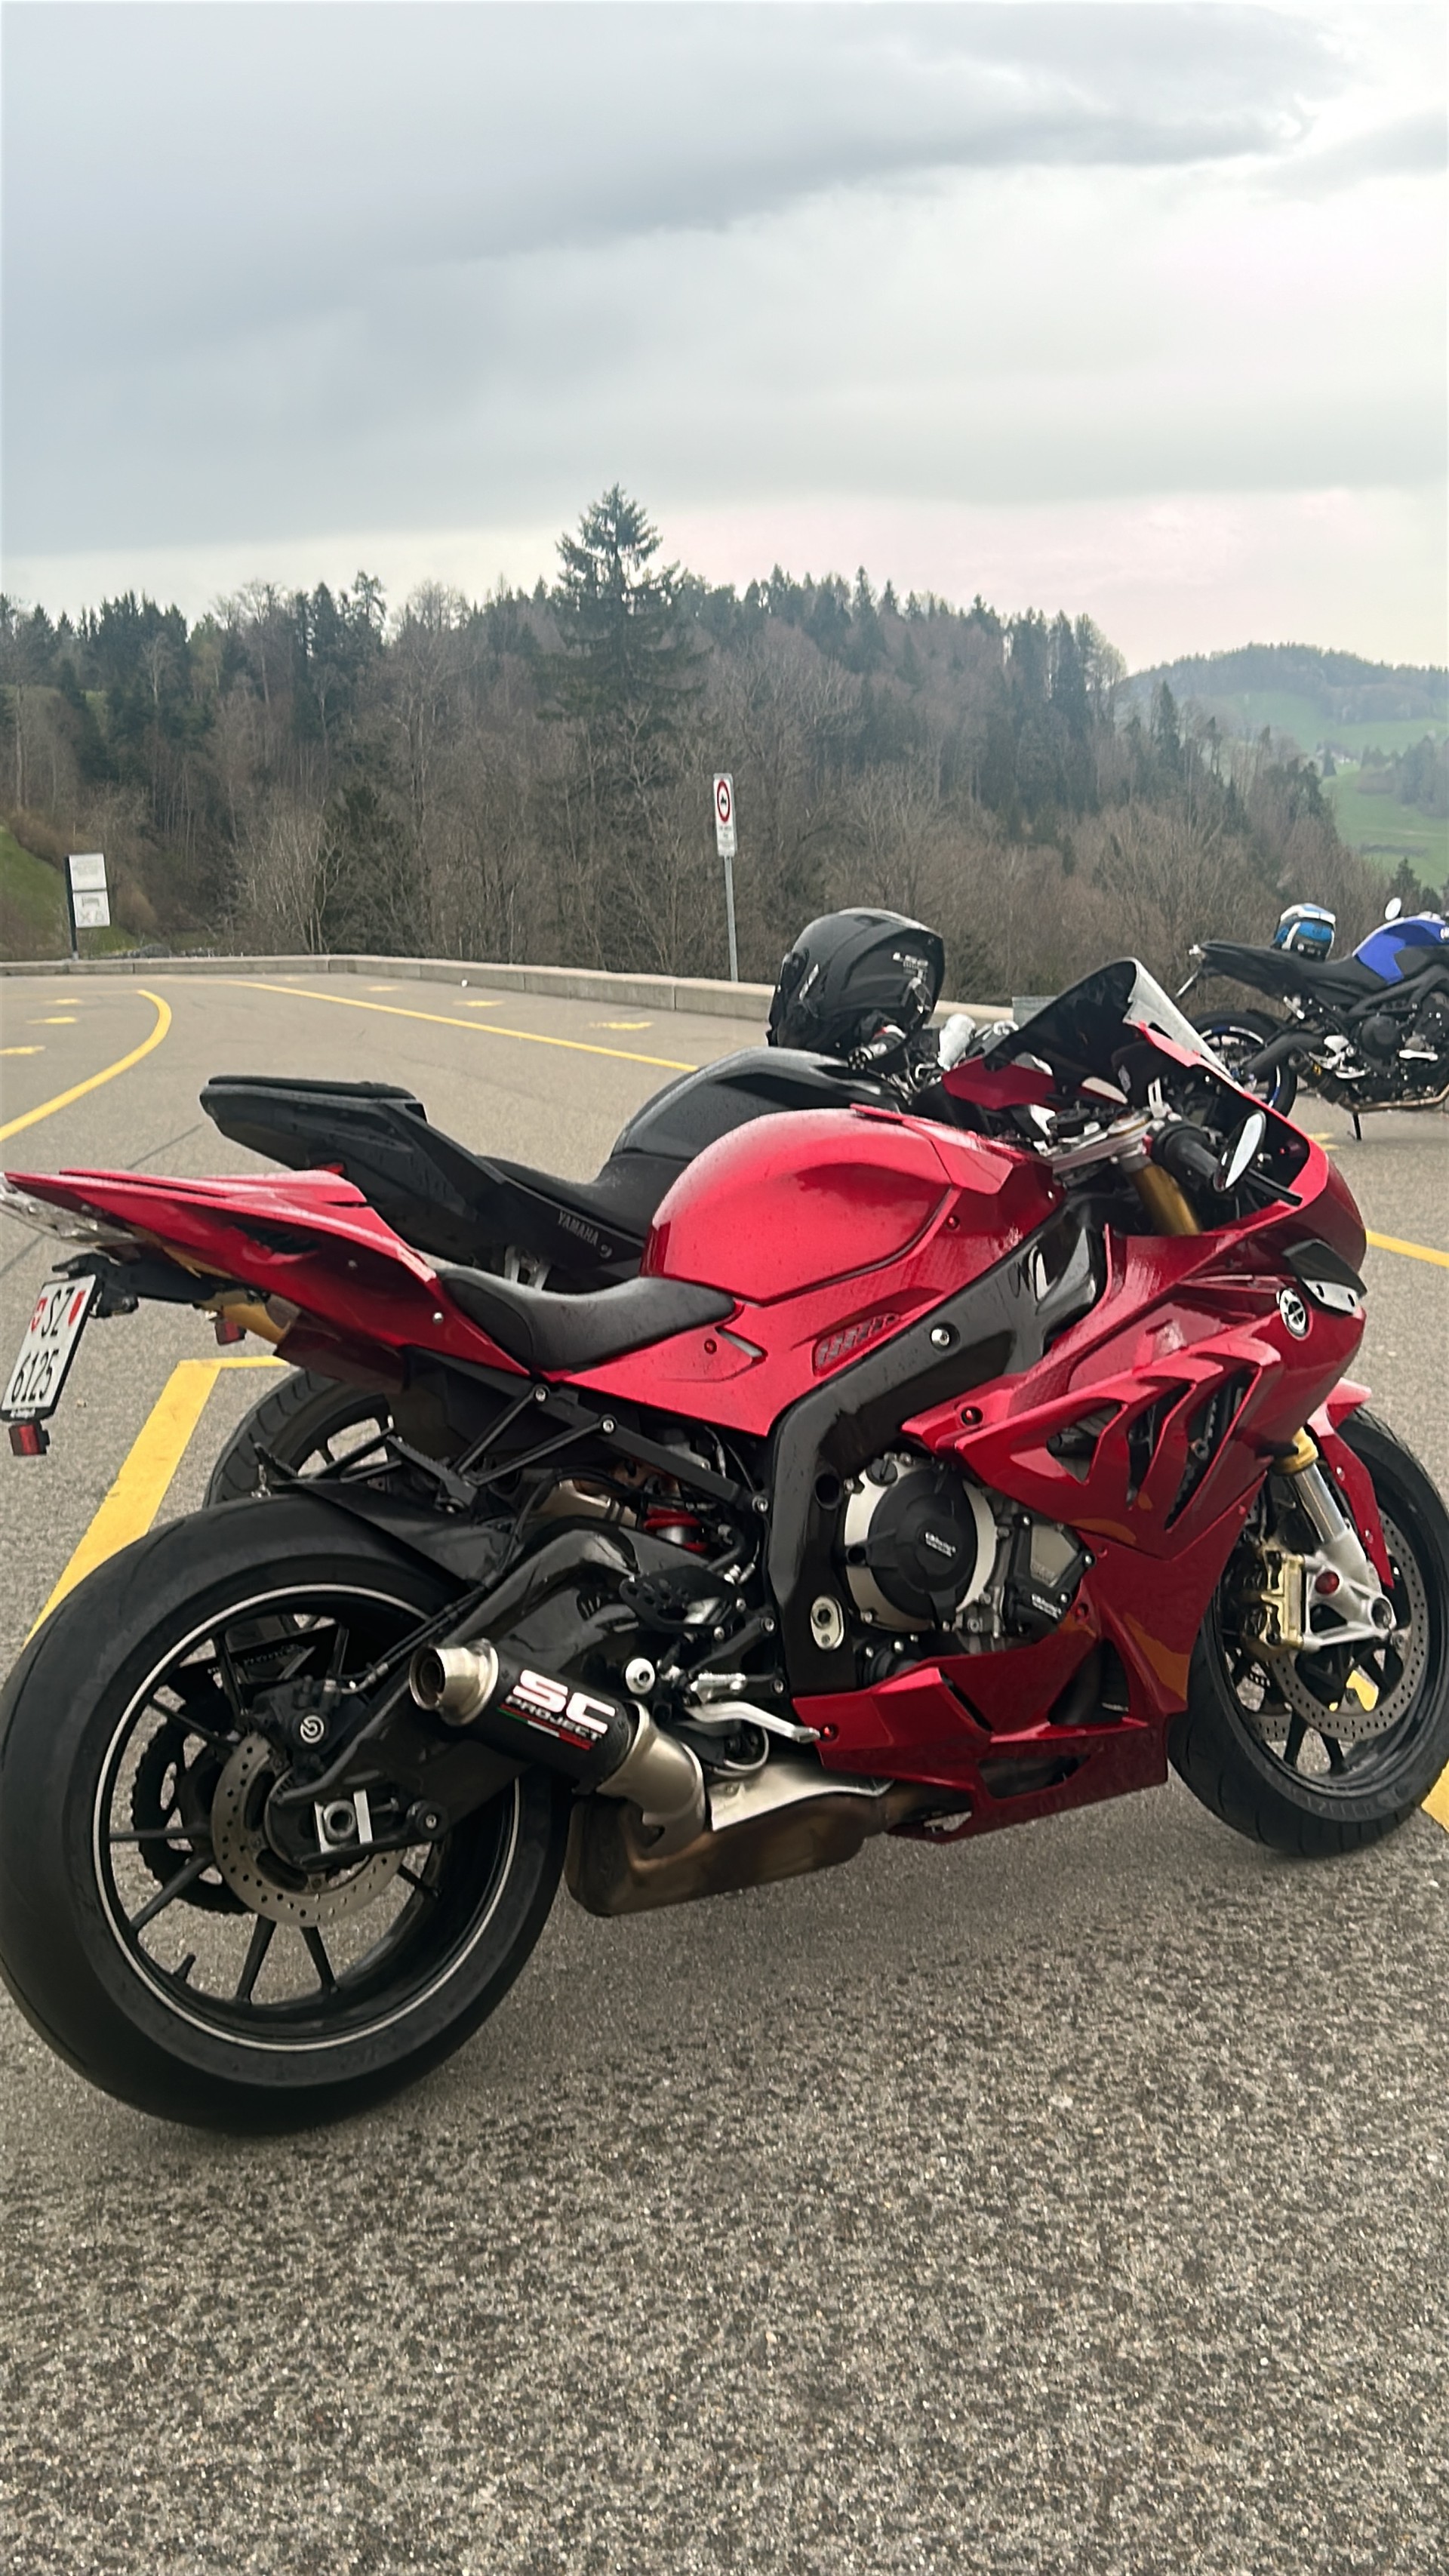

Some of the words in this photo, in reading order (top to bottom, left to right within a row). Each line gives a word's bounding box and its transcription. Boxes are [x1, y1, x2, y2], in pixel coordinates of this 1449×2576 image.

[558, 1209, 598, 1247] YAMAHA
[41, 1286, 75, 1337] SZ
[11, 1349, 58, 1402] 6125
[505, 1694, 602, 1741] PROJECT
[512, 1669, 616, 1734] SC
